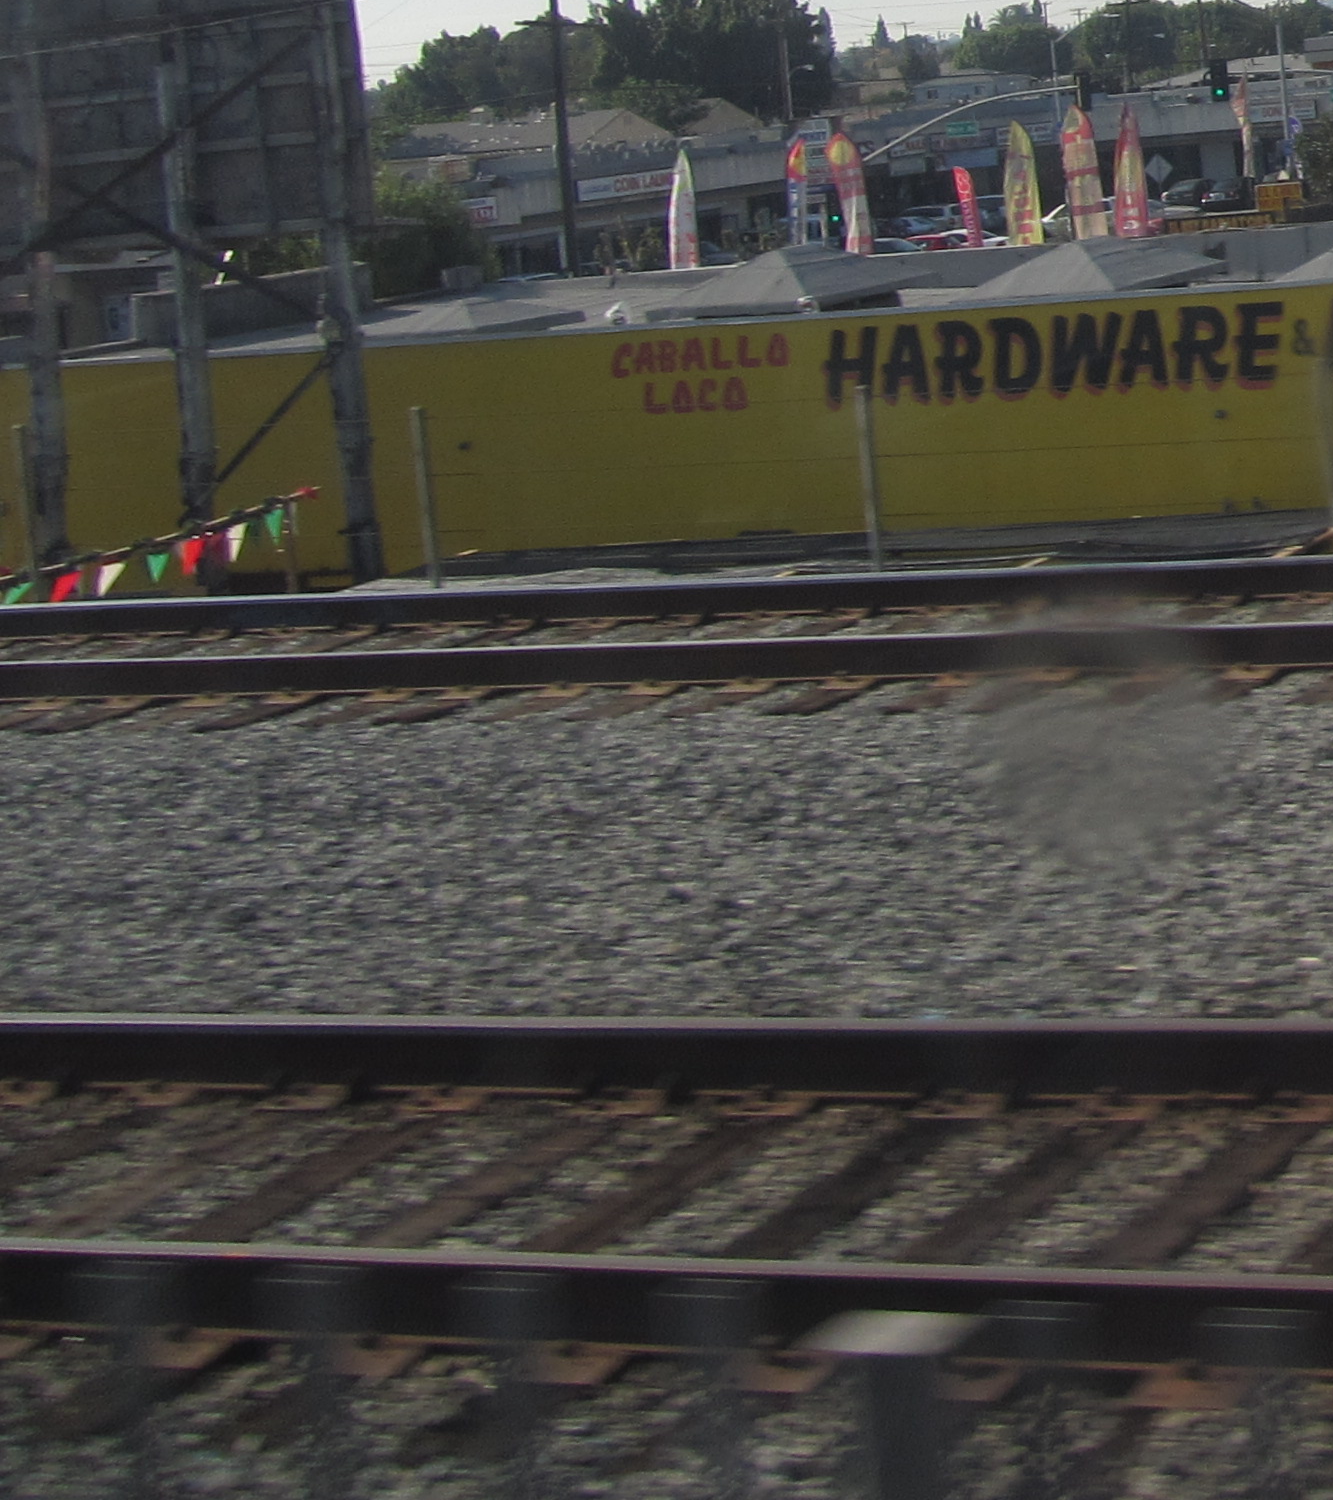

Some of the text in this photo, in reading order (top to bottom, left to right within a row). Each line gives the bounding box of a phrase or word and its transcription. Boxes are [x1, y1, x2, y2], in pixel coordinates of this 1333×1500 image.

[612, 332, 791, 380] CABALLO
[823, 301, 1284, 411] HARDWARE
[643, 376, 749, 415] LOCO
